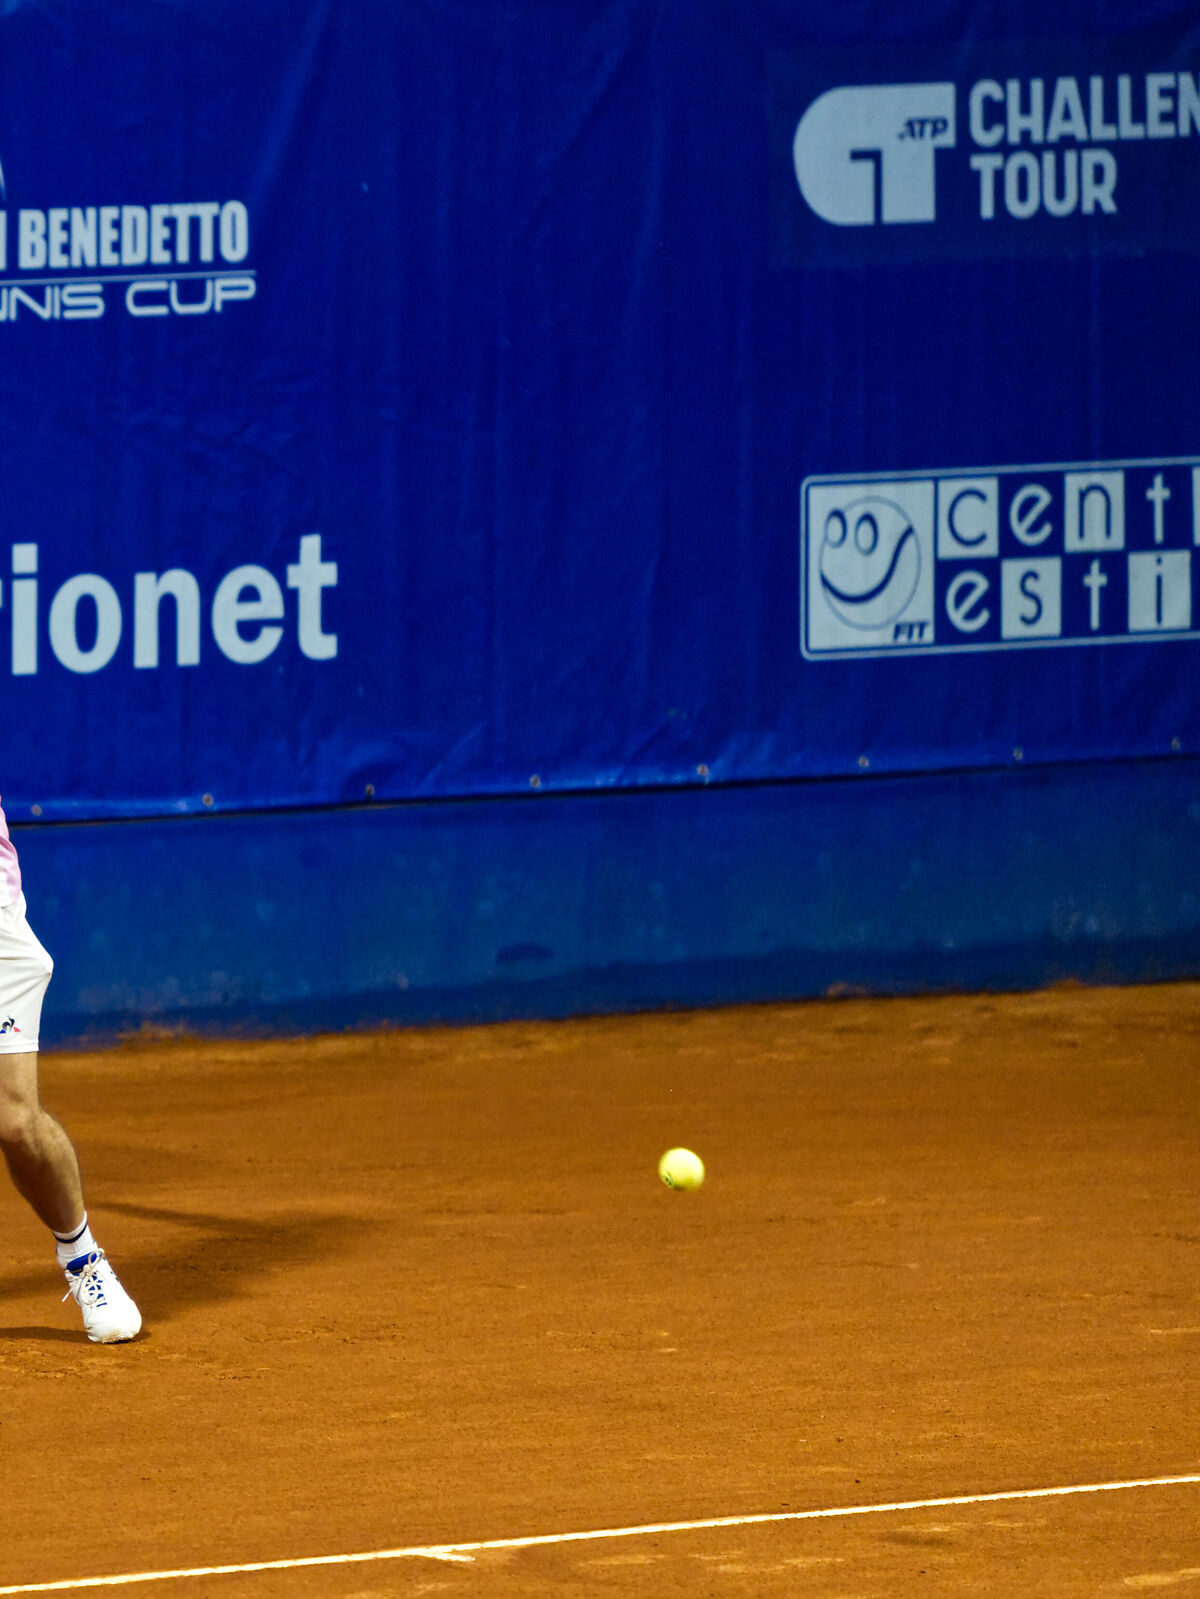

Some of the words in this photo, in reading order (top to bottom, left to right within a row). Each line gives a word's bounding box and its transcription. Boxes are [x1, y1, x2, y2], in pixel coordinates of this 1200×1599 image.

[899, 116, 949, 141] ATP
[969, 147, 1118, 221] TOUR
[18, 200, 249, 270] BENEDETTO
[126, 276, 257, 317] CUP
[946, 554, 1163, 635] esti
[893, 620, 931, 641] FIT
